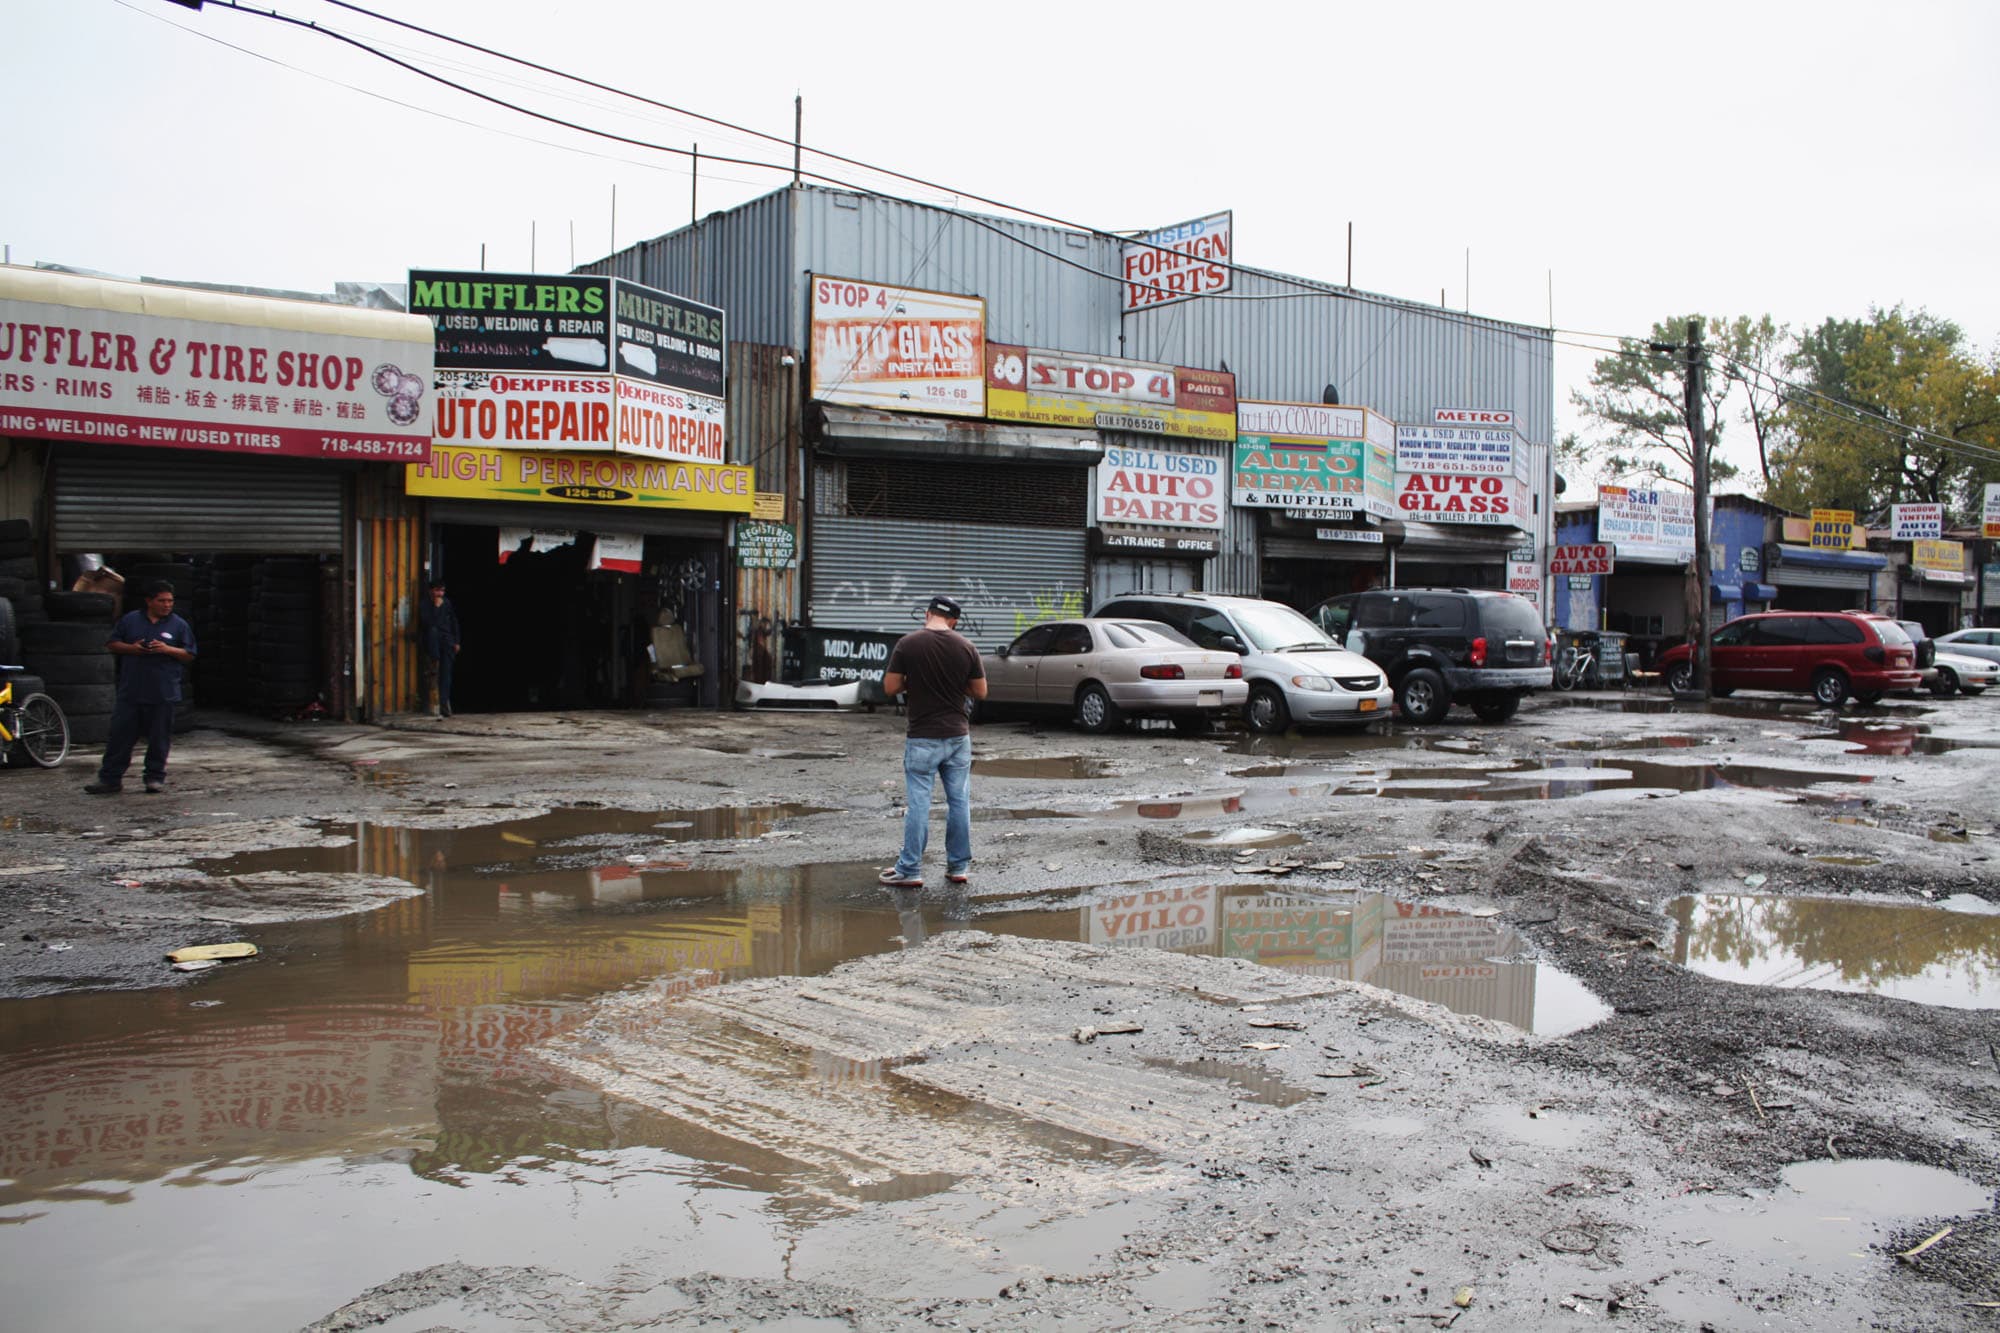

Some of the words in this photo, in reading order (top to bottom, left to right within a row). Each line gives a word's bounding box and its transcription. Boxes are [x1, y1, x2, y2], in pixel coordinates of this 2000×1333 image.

[1146, 221, 1205, 246] USED
[1125, 231, 1228, 280] FOREIGN
[1128, 261, 1225, 308] PARTS
[413, 280, 605, 314] MUFFLERS
[818, 281, 869, 308] STOP
[876, 289, 888, 310] 4
[446, 315, 479, 330] USED
[484, 317, 539, 333] WELDING
[544, 320, 553, 333] &
[559, 320, 604, 334] REPAIR
[617, 290, 721, 343] MUFFLERS
[616, 322, 633, 339] NEW
[635, 327, 655, 345] USED
[656, 333, 687, 354] WELDING
[696, 344, 721, 362] REPAIR
[824, 326, 890, 360] AUTO
[898, 325, 973, 362] GLASS
[149, 337, 177, 375] &
[186, 341, 268, 384] TIRE
[276, 350, 364, 392] SHOP
[888, 361, 973, 375] INSTALLED
[0, 373, 35, 393] RS
[56, 378, 113, 400] RIMS
[509, 379, 611, 393] EXPRESS
[1148, 374, 1170, 398] 4
[1187, 383, 1225, 396] PARTS
[185, 388, 218, 409] 板金
[628, 387, 684, 410] EXPRESS
[505, 400, 610, 442] REPAIR
[1019, 410, 1050, 421] WILLETS
[1053, 414, 1075, 424] POINT
[1121, 416, 1165, 431] 7065261
[1240, 408, 1281, 431] JULIO
[1285, 406, 1361, 437] COMPLETE
[1436, 410, 1510, 423] METRO
[139, 425, 178, 441] NEW
[234, 432, 282, 448] TIRES
[619, 404, 665, 450] AUTO
[668, 414, 723, 461] REPAIR
[1399, 427, 1418, 438] NEW
[1433, 429, 1454, 439] USED
[1459, 430, 1481, 441] AUTO
[1485, 432, 1511, 442] GLASS
[321, 437, 424, 456] 718-458-7124
[416, 450, 502, 481] HIGH
[520, 456, 748, 495] PERFORMANCE
[1108, 449, 1159, 470] SELL
[1164, 455, 1218, 476] USED
[1240, 451, 1358, 474] AUTO
[1106, 470, 1214, 499] AUTO
[1235, 472, 1364, 495] REPAIR
[1404, 473, 1504, 495] AUTO
[1246, 493, 1259, 503] &
[1265, 493, 1354, 507] MUFFLER
[1398, 493, 1510, 514] GLASS
[1628, 488, 1658, 505] S&R
[1102, 496, 1219, 523] PARTS
[1435, 512, 1465, 522] WILLETS
[1613, 511, 1657, 522] TRANSMISSION
[1898, 513, 1941, 521] TINTING
[1899, 505, 1937, 513] WINDOW
[739, 525, 793, 542] REGISTERED
[1814, 521, 1853, 534] AUTO
[1900, 521, 1938, 530] AUTO
[1177, 539, 1213, 550] OFFICE
[1812, 534, 1851, 548] BODY
[1555, 545, 1607, 559] AUTO
[1550, 559, 1609, 574] GLASS
[1510, 577, 1540, 591] MIRRORS
[824, 639, 888, 660] MIDLAND
